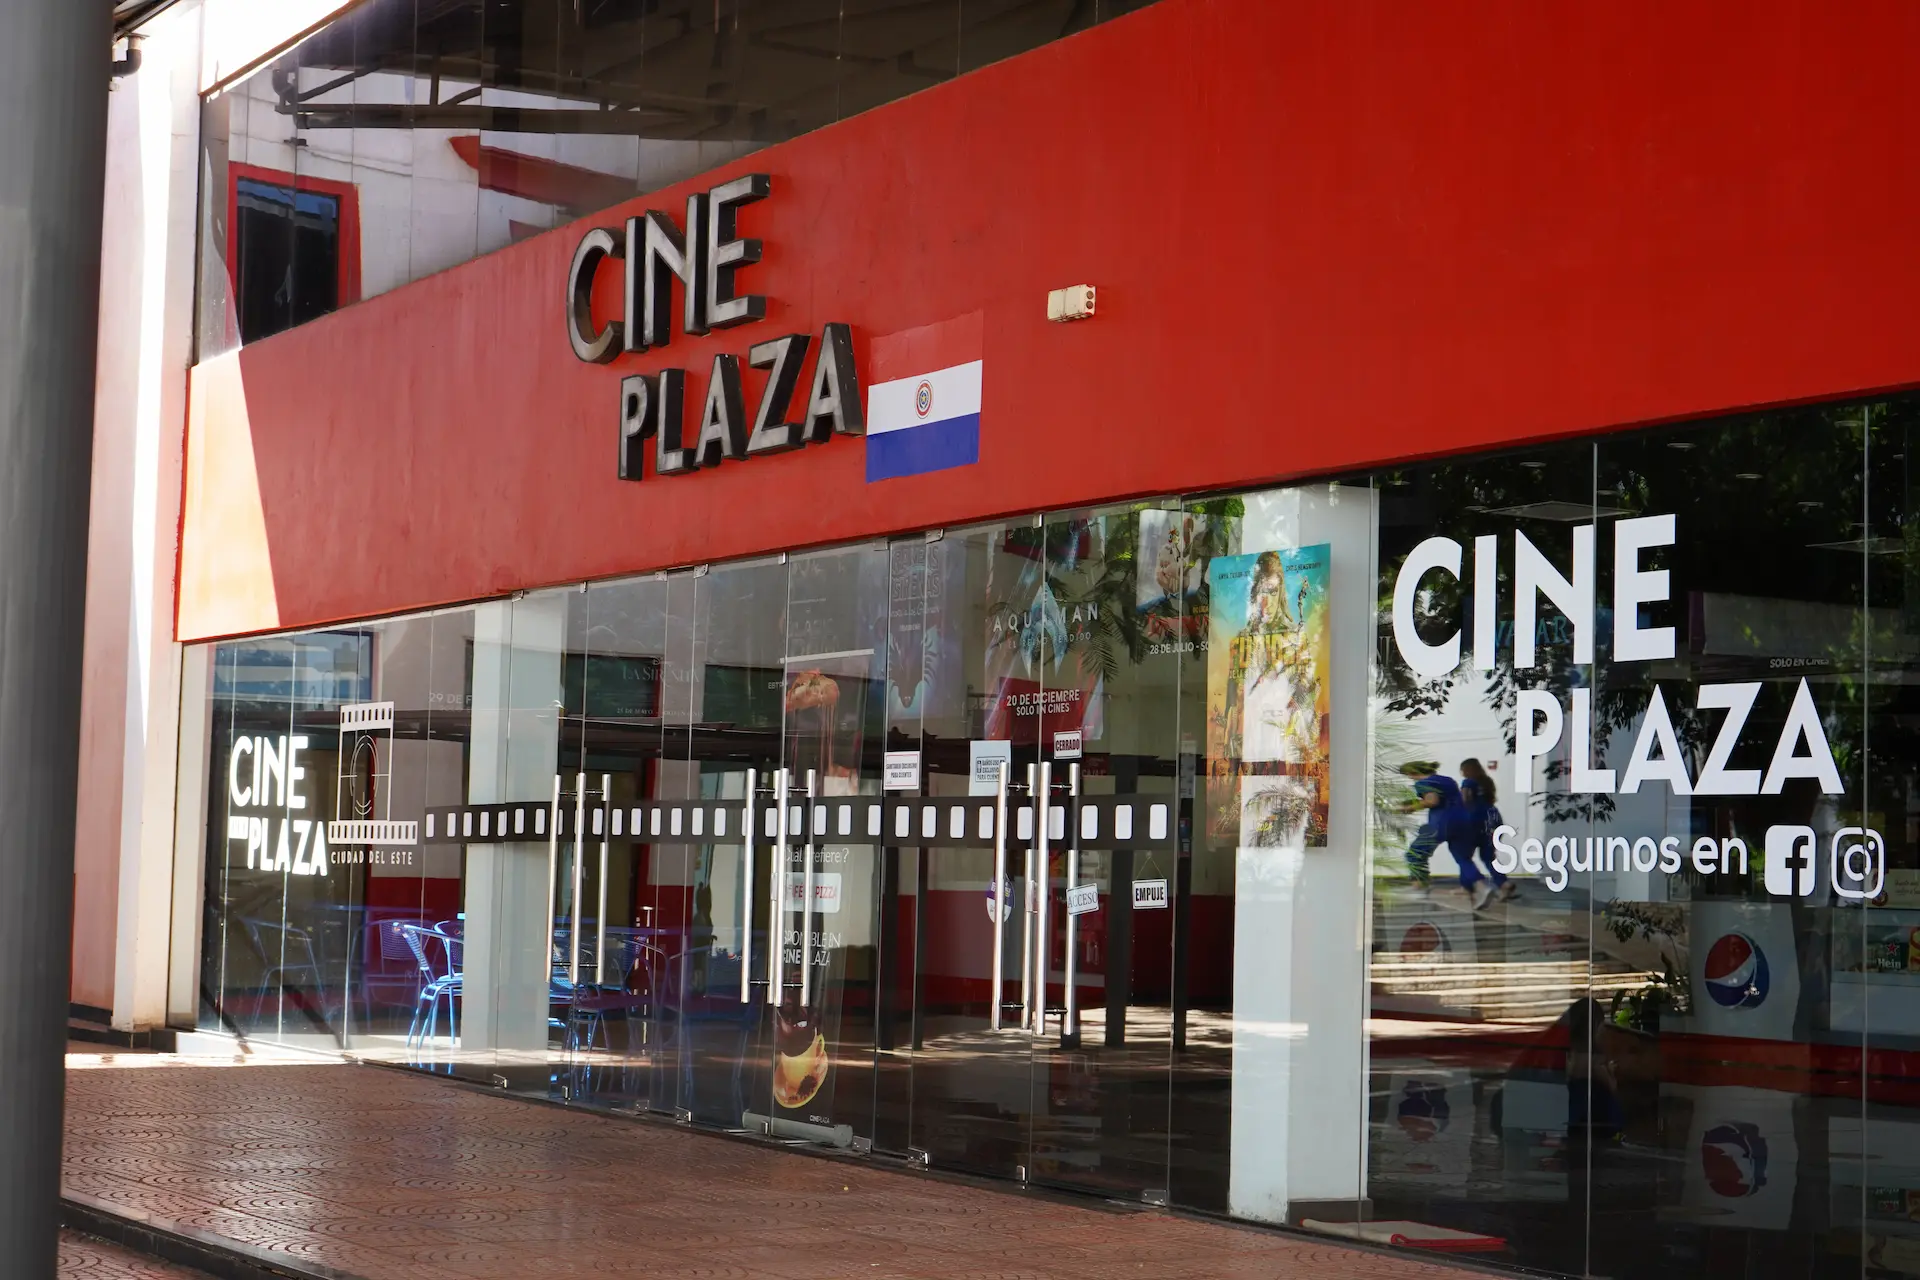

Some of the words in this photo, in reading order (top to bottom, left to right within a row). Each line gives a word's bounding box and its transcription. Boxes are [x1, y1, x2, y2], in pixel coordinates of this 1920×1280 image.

[566, 174, 770, 365] CINE
[618, 323, 864, 481] PLAZA
[1393, 514, 1676, 677] CINE
[1150, 644, 1160, 655] 28
[1160, 643, 1171, 654] DE
[1769, 658, 1792, 669] SOLO
[1006, 694, 1017, 707] 20
[1019, 693, 1030, 706] DE
[1016, 705, 1035, 716] SOLO
[1047, 703, 1070, 714] CINES
[1514, 676, 1845, 795] PLAZA
[1055, 738, 1080, 752] CERRADO
[229, 735, 309, 809] CINE
[248, 816, 329, 877] PLAZA
[1692, 835, 1748, 875] en
[330, 850, 364, 864] CIUDAD
[368, 850, 386, 864] DEL
[390, 850, 413, 865] ESTE
[1067, 891, 1098, 908] ACCESO
[1135, 886, 1164, 902] EMPUJE
